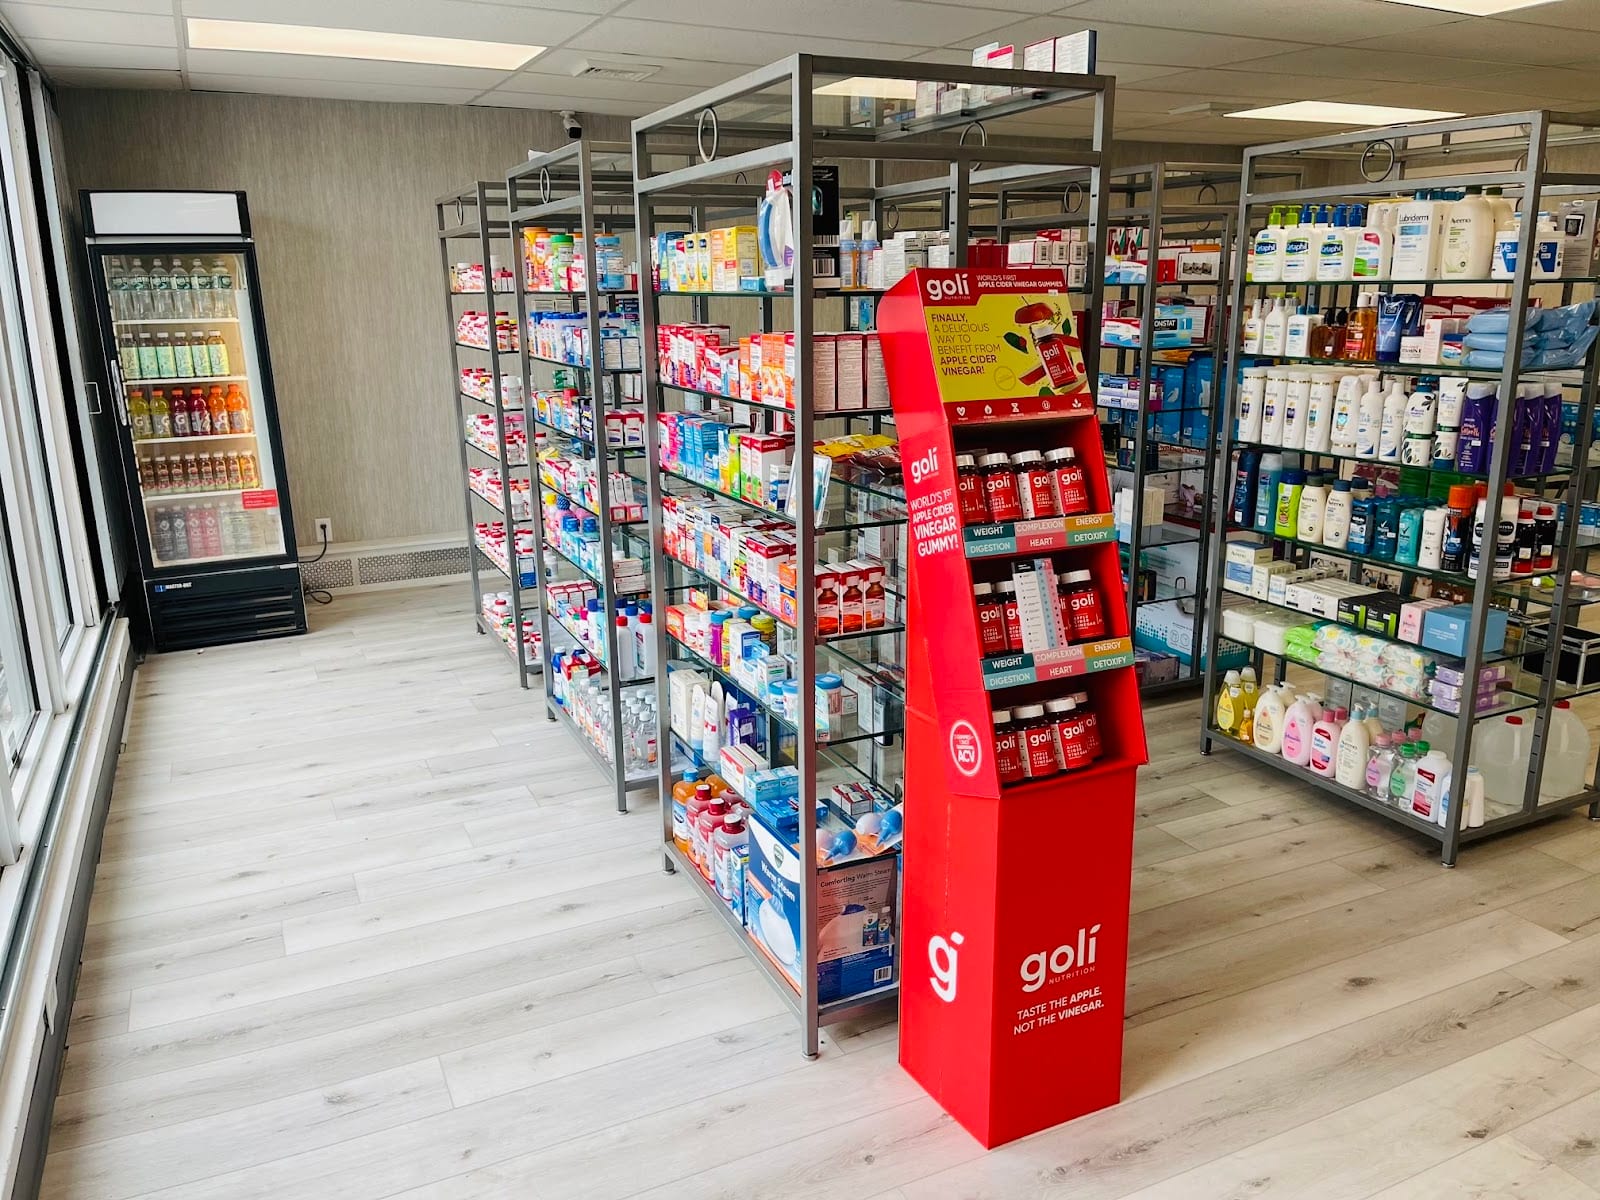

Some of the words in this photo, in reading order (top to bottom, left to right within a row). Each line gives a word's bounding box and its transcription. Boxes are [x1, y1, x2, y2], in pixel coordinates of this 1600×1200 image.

[926, 273, 970, 301] goli
[1038, 280, 1063, 288] GUMMIES
[931, 313, 968, 323] FINALLY,
[934, 324, 940, 333] A
[942, 323, 990, 333] DELICIOUS
[935, 335, 955, 344] WAY
[958, 334, 971, 343] TO
[938, 344, 973, 355] BENEFIT
[975, 343, 1001, 353] FROM
[940, 355, 968, 366] APPLE
[970, 354, 997, 364] CIDER
[941, 366, 985, 376] VINEGAR!
[911, 447, 938, 484] goli
[959, 477, 975, 491] oli
[986, 475, 1010, 492] goli
[1033, 473, 1050, 488] gol
[1061, 468, 1083, 486] goli
[910, 491, 943, 511] WORLD'S
[912, 509, 933, 524] APPLE
[932, 502, 954, 519] CIDER
[914, 516, 957, 540] VINEGAR
[973, 526, 1004, 537] WEIGHT
[1016, 521, 1064, 532] COMPLEXION
[1076, 516, 1103, 526] ENERGY
[918, 534, 959, 558] GUMMY!
[970, 542, 1011, 554] DIGESTION
[1030, 537, 1053, 547] HEART
[1074, 531, 1109, 542] DETOXIFY
[1070, 594, 1094, 610] goli
[980, 606, 1000, 623] goli
[992, 656, 1022, 670] WEIGHT
[1035, 648, 1082, 662] COMPLEXION
[1094, 641, 1122, 652] ENERGY
[990, 673, 1030, 687] DIGESTION
[1050, 666, 1072, 677] HEART
[1093, 656, 1127, 669] DETOXIFY
[1086, 714, 1096, 726] oli
[1030, 729, 1052, 747] goli
[1063, 721, 1084, 740] goli
[958, 750, 975, 762] ACV
[820, 876, 856, 888] Comforting
[1020, 923, 1101, 993] goli
[1048, 966, 1096, 985] NUTRITION
[1016, 1004, 1046, 1020] TASTE
[1049, 997, 1068, 1011] THE
[1069, 986, 1102, 1004] APPLE.
[1013, 1020, 1035, 1036] NOT
[1037, 1013, 1056, 1028] THE
[1058, 1000, 1104, 1020] VINEGAR.
